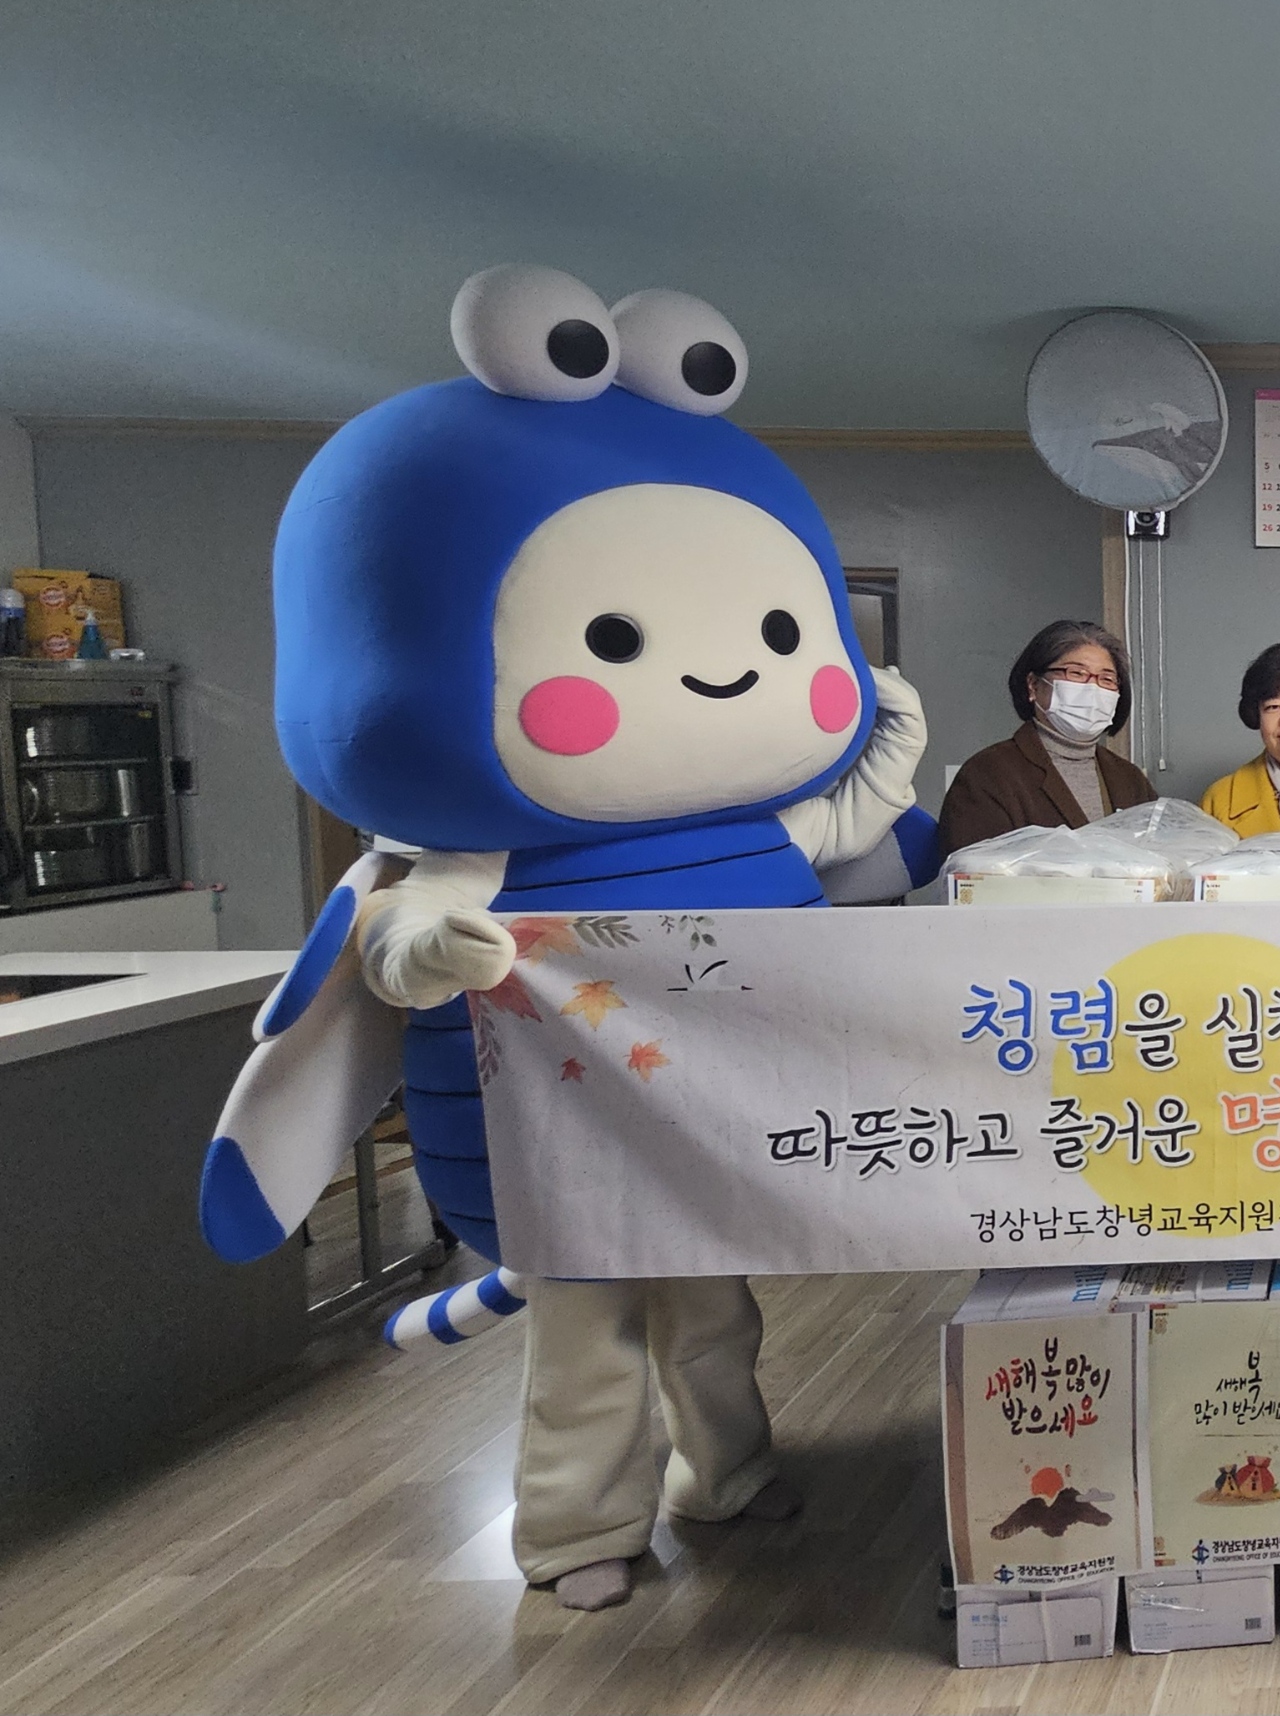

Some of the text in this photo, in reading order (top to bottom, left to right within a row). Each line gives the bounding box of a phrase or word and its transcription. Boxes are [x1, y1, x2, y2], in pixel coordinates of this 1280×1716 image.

[1263, 483, 1272, 491] 12
[1263, 524, 1273, 532] 26
[962, 979, 1185, 1072] 청렴을
[767, 1107, 1019, 1177] 따뜻하고
[1040, 1098, 1198, 1170] 즐거운
[985, 1337, 1111, 1401] 새해 복 많이
[1216, 1351, 1263, 1404] 새해 복
[1002, 1394, 1098, 1438] 받으세요
[1194, 1399, 1228, 1426] 많이
[1017, 1556, 1115, 1577] 경상남도창녕교육지원청
